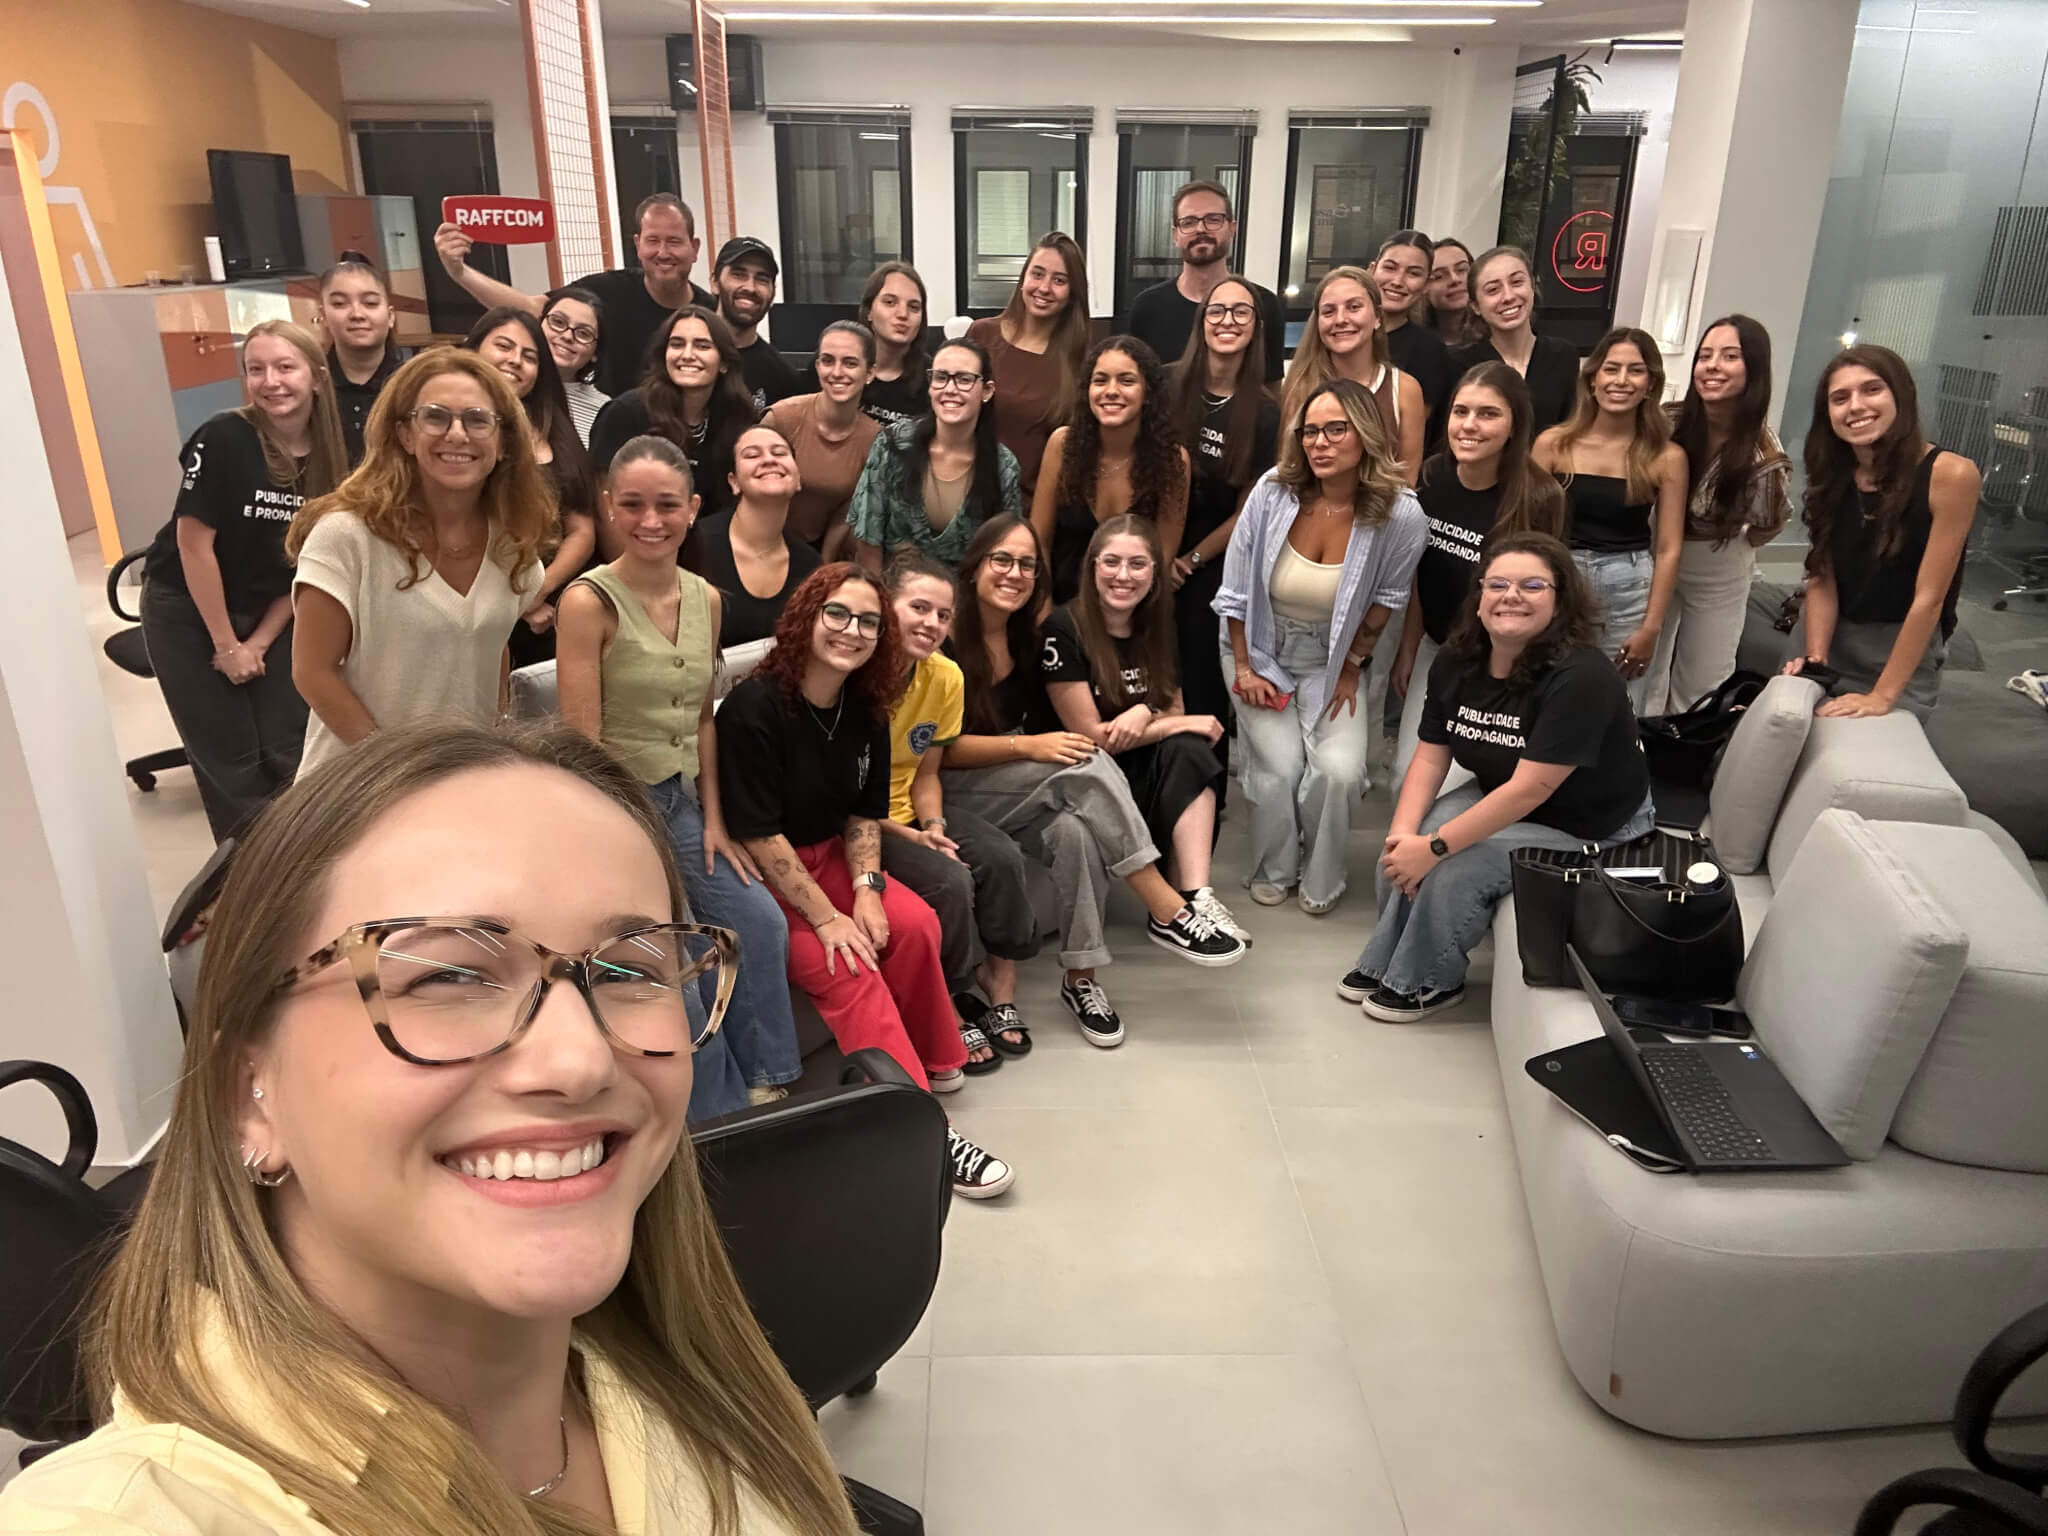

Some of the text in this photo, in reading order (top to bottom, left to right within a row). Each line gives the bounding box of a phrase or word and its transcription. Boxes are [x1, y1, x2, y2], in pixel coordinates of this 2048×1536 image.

[455, 208, 544, 227] RAFFCOM
[255, 489, 306, 507] PUBLICID
[243, 505, 296, 521] E PROPA
[1427, 534, 1481, 564] OPAGANDA
[1457, 705, 1520, 729] PUBLICIDADE
[1446, 720, 1526, 748] E PROPAGANDA
